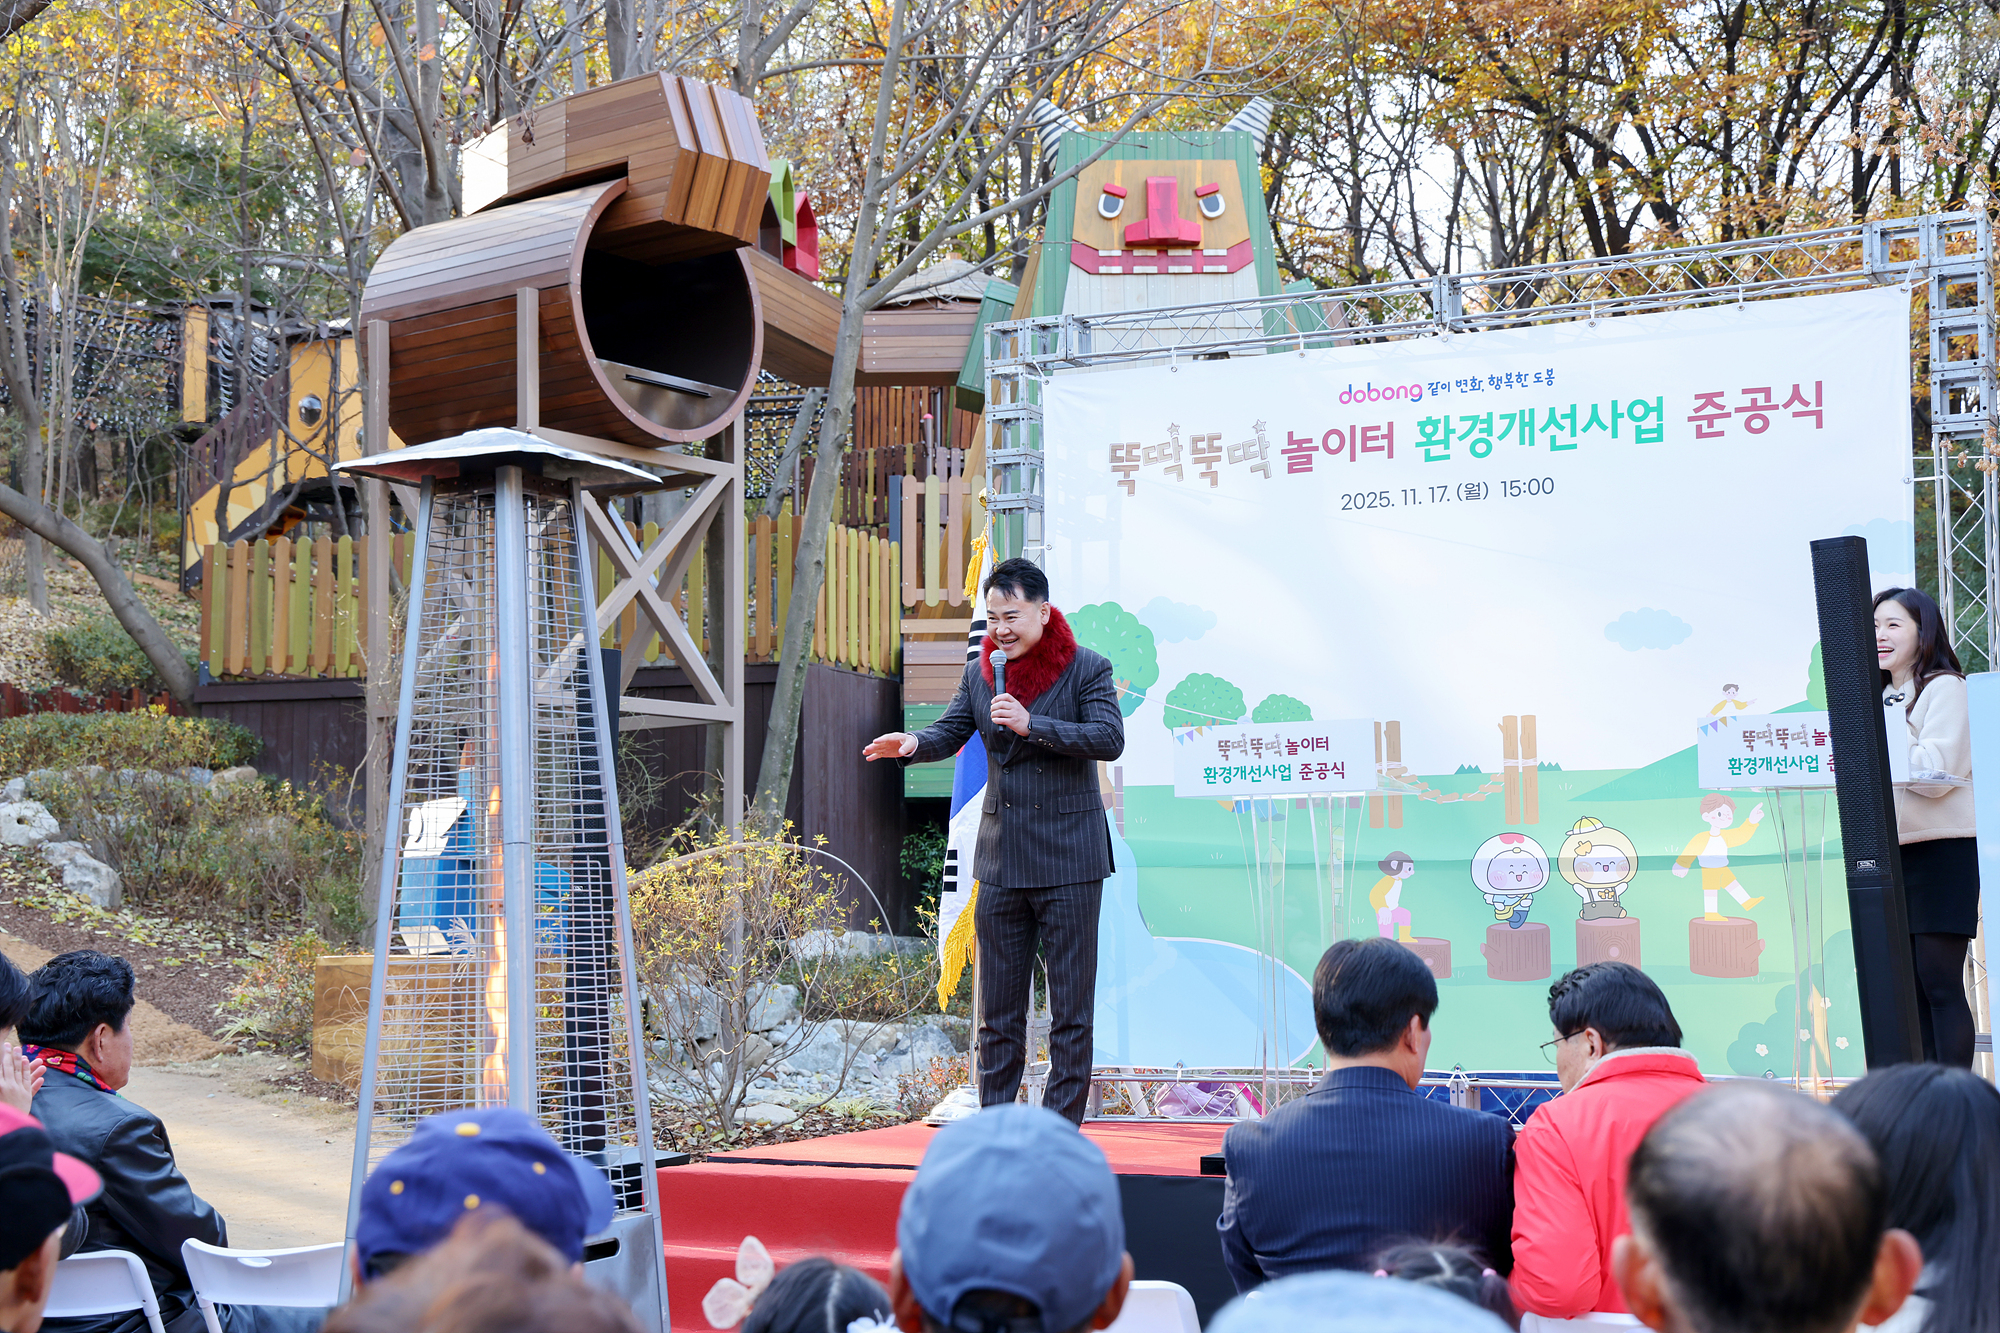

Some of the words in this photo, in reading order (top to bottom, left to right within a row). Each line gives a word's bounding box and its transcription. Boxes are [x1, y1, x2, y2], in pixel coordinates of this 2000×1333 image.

[1338, 381, 1423, 405] dobong
[1427, 381, 1451, 397] 같이
[1455, 375, 1485, 394] 변화,
[1488, 371, 1529, 390] 행복한
[1533, 367, 1556, 387] 도봉
[1108, 431, 1273, 497] 뚝딱뚝딱
[1280, 421, 1394, 475] 놀이터
[1414, 395, 1665, 463] 환경개선사업
[1687, 380, 1824, 440] 준공식
[1341, 490, 1395, 511] 2025.
[1401, 488, 1422, 506] 11.
[1428, 485, 1451, 503] 17.
[1456, 481, 1489, 502] (월)
[1500, 477, 1555, 498] 15:00
[1217, 736, 1282, 761] 뚝딱뚝딱
[1284, 736, 1329, 755] 놀이터
[1742, 727, 1809, 752] 뚝딱뚝딱
[1203, 763, 1292, 784] 환경개선사업
[1299, 761, 1346, 781] 준공식
[1727, 754, 1820, 776] 환경개선사업
